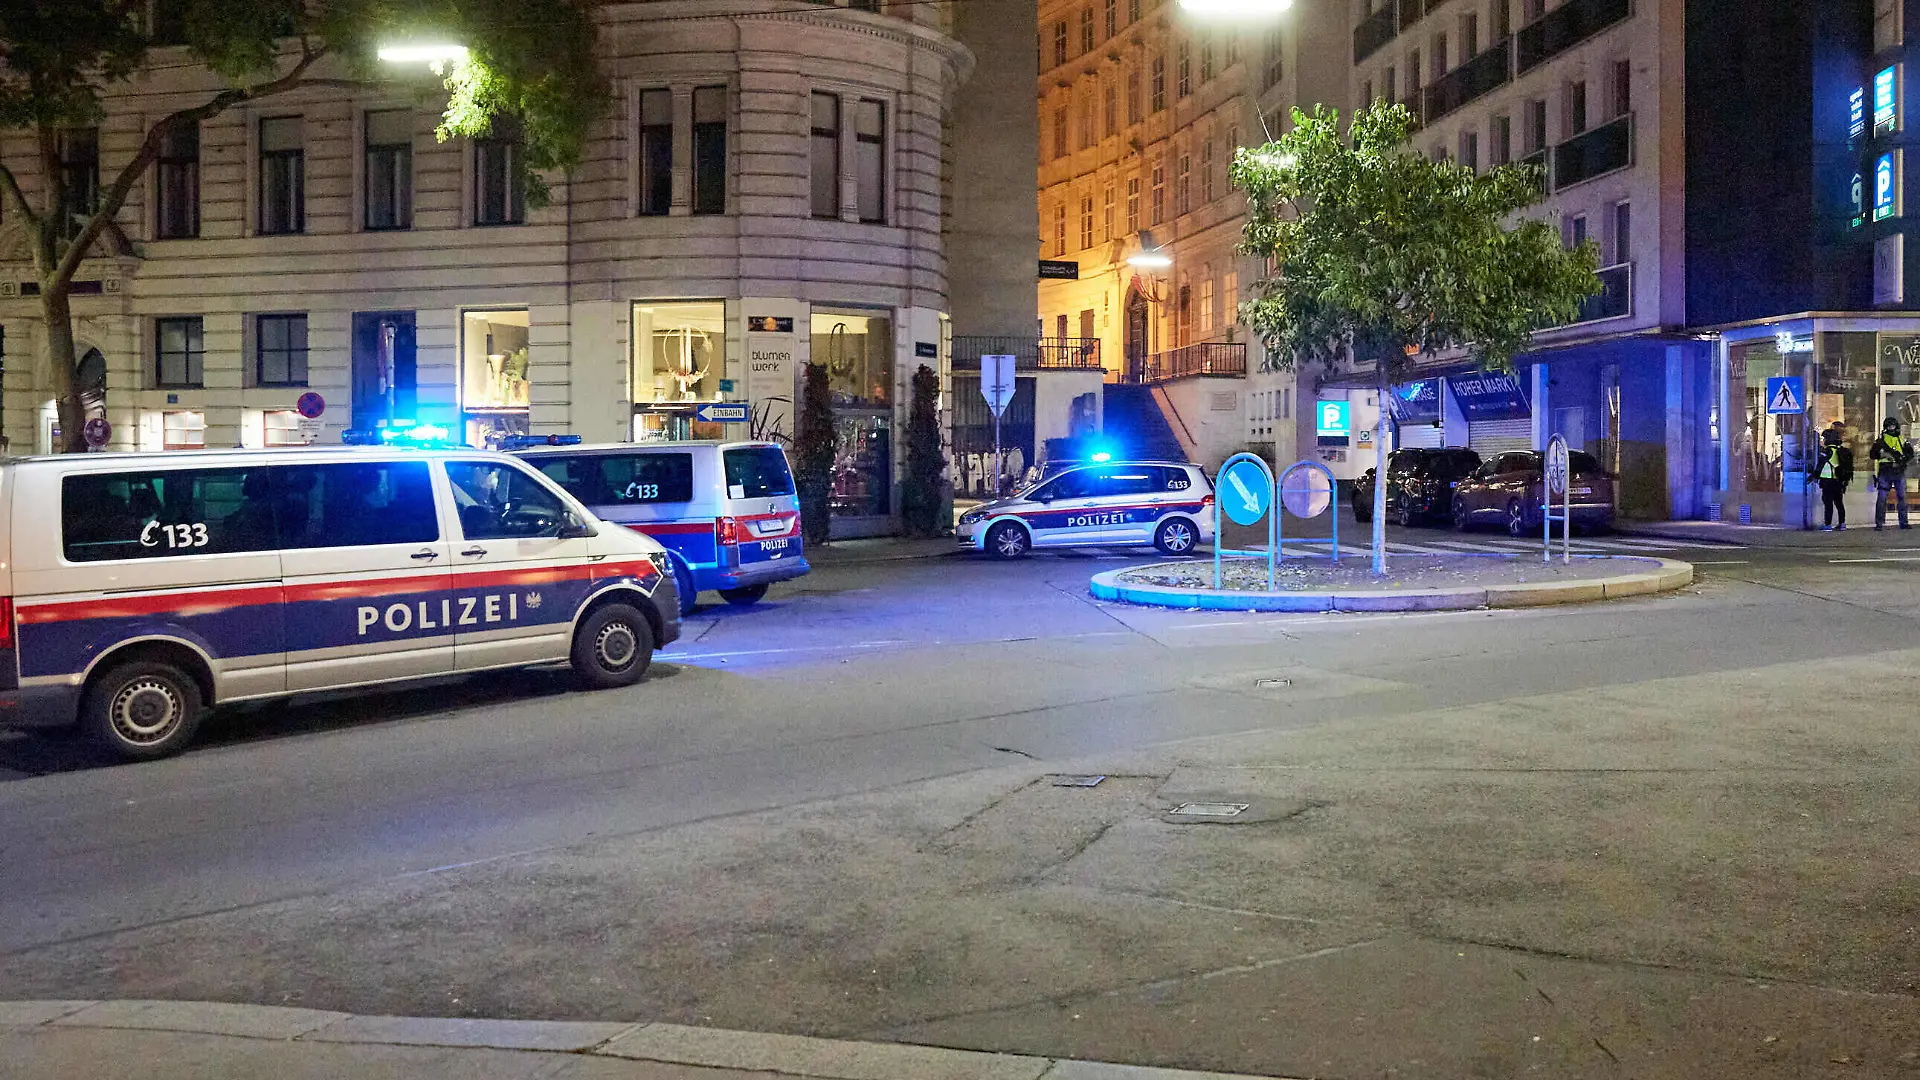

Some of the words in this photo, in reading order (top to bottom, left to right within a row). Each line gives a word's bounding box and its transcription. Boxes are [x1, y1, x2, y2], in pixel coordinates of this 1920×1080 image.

[1877, 171, 1890, 206] P
[752, 351, 790, 361] blumen
[752, 362, 779, 372] werk
[1452, 380, 1485, 397] HOHER
[713, 409, 743, 417] EINBAHN
[1323, 408, 1340, 429] P
[636, 484, 659, 499] 133
[1173, 480, 1188, 490] 133
[1067, 513, 1125, 527] POLIZEI
[162, 522, 209, 548] 133
[760, 539, 788, 551] POLIZEI
[357, 593, 517, 636] POLIZEI
